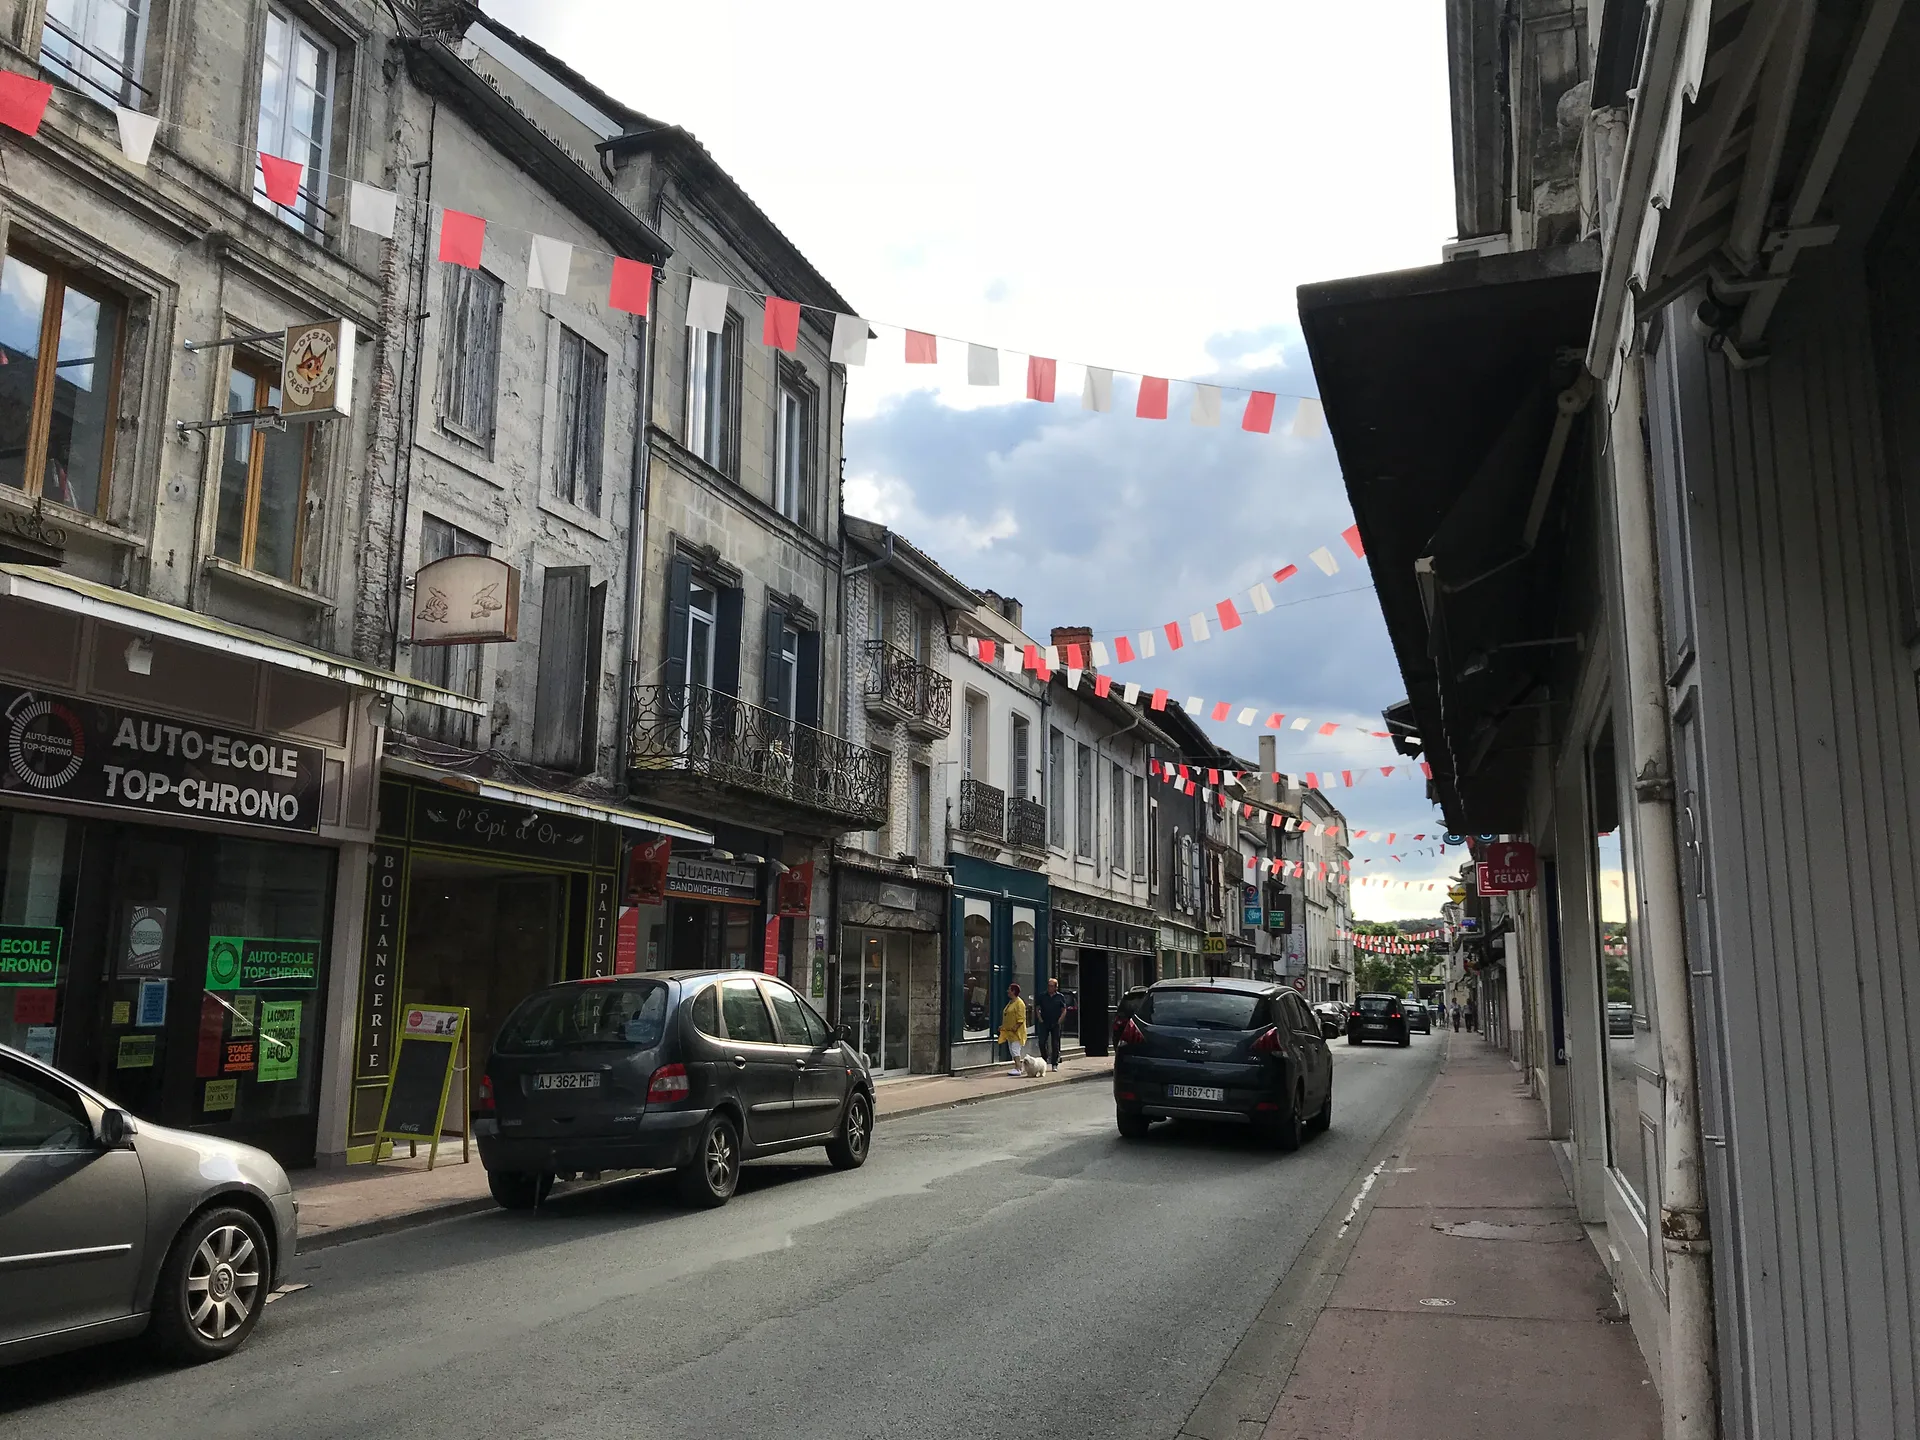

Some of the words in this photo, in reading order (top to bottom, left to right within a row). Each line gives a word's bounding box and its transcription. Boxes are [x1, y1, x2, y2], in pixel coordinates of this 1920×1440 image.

[292, 331, 336, 355] LOISIRS
[287, 366, 335, 395] CRÉATIFS
[25, 732, 72, 746] AUTO-ECOLE
[22, 741, 72, 756] TOP-CHRONO
[112, 716, 298, 778] AUTO-ECOLE
[103, 764, 299, 822] TOP-CHRONO
[669, 880, 730, 897] SANDWICHERIE
[1203, 939, 1225, 951] BIO
[247, 951, 314, 964] AUTO-ECOLE
[369, 855, 395, 1068] BOULANGERIE
[243, 966, 315, 979] TOP-CHRONO
[227, 1044, 253, 1053] STAGE
[228, 1053, 252, 1062] CODE
